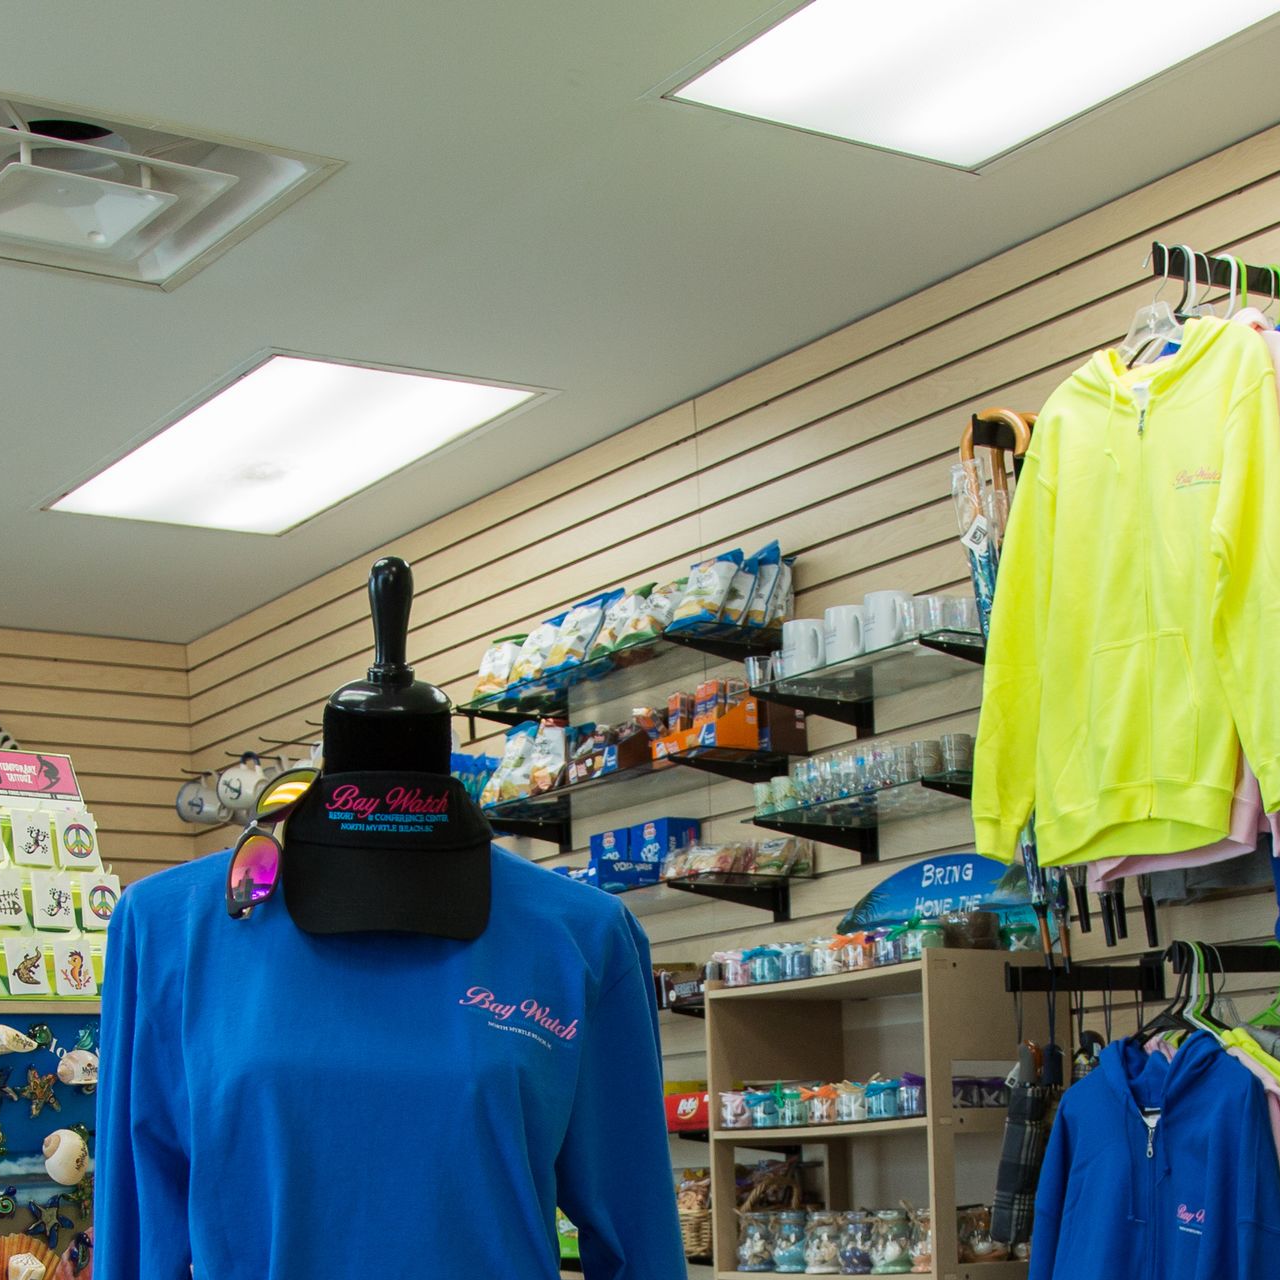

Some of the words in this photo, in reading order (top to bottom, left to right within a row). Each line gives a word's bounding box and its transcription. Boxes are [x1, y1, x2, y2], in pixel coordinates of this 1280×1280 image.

[325, 784, 380, 818] Bay
[386, 786, 449, 813] Watch
[328, 811, 355, 820] RESORT
[374, 813, 424, 823] CONFERENCE
[425, 814, 449, 822] CENTER
[340, 823, 365, 831] NORTH
[366, 824, 397, 832] MYRTLE
[921, 863, 974, 888] BRING
[915, 897, 953, 917] HOME
[959, 894, 982, 915] THE
[459, 986, 517, 1020] Bay
[520, 999, 578, 1040] Watch
[487, 1021, 508, 1031] NORTH
[508, 1026, 532, 1037] MYRTLE
